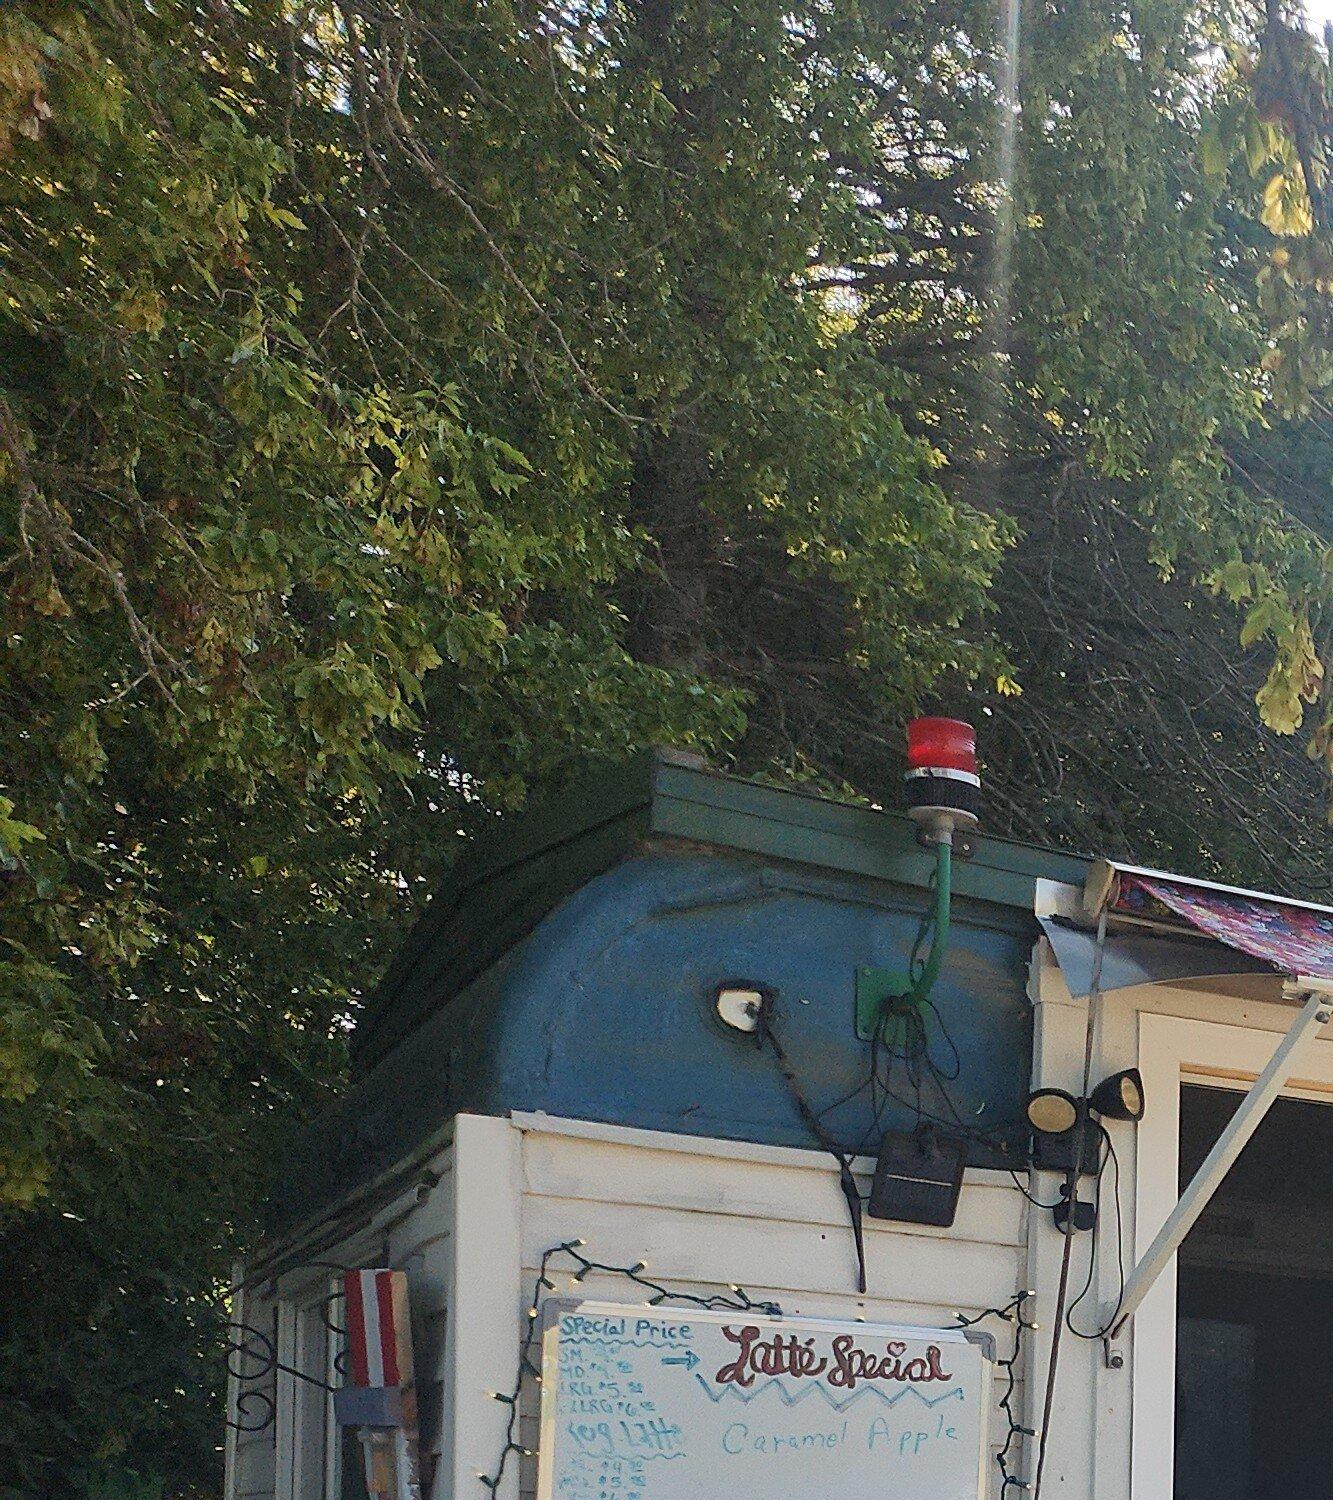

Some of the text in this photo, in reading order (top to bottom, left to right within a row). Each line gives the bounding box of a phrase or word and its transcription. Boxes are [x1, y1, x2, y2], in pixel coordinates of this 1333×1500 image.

[636, 1320, 694, 1339] Price
[827, 1335, 952, 1389] Special
[722, 1414, 958, 1454] Caramel Apple
